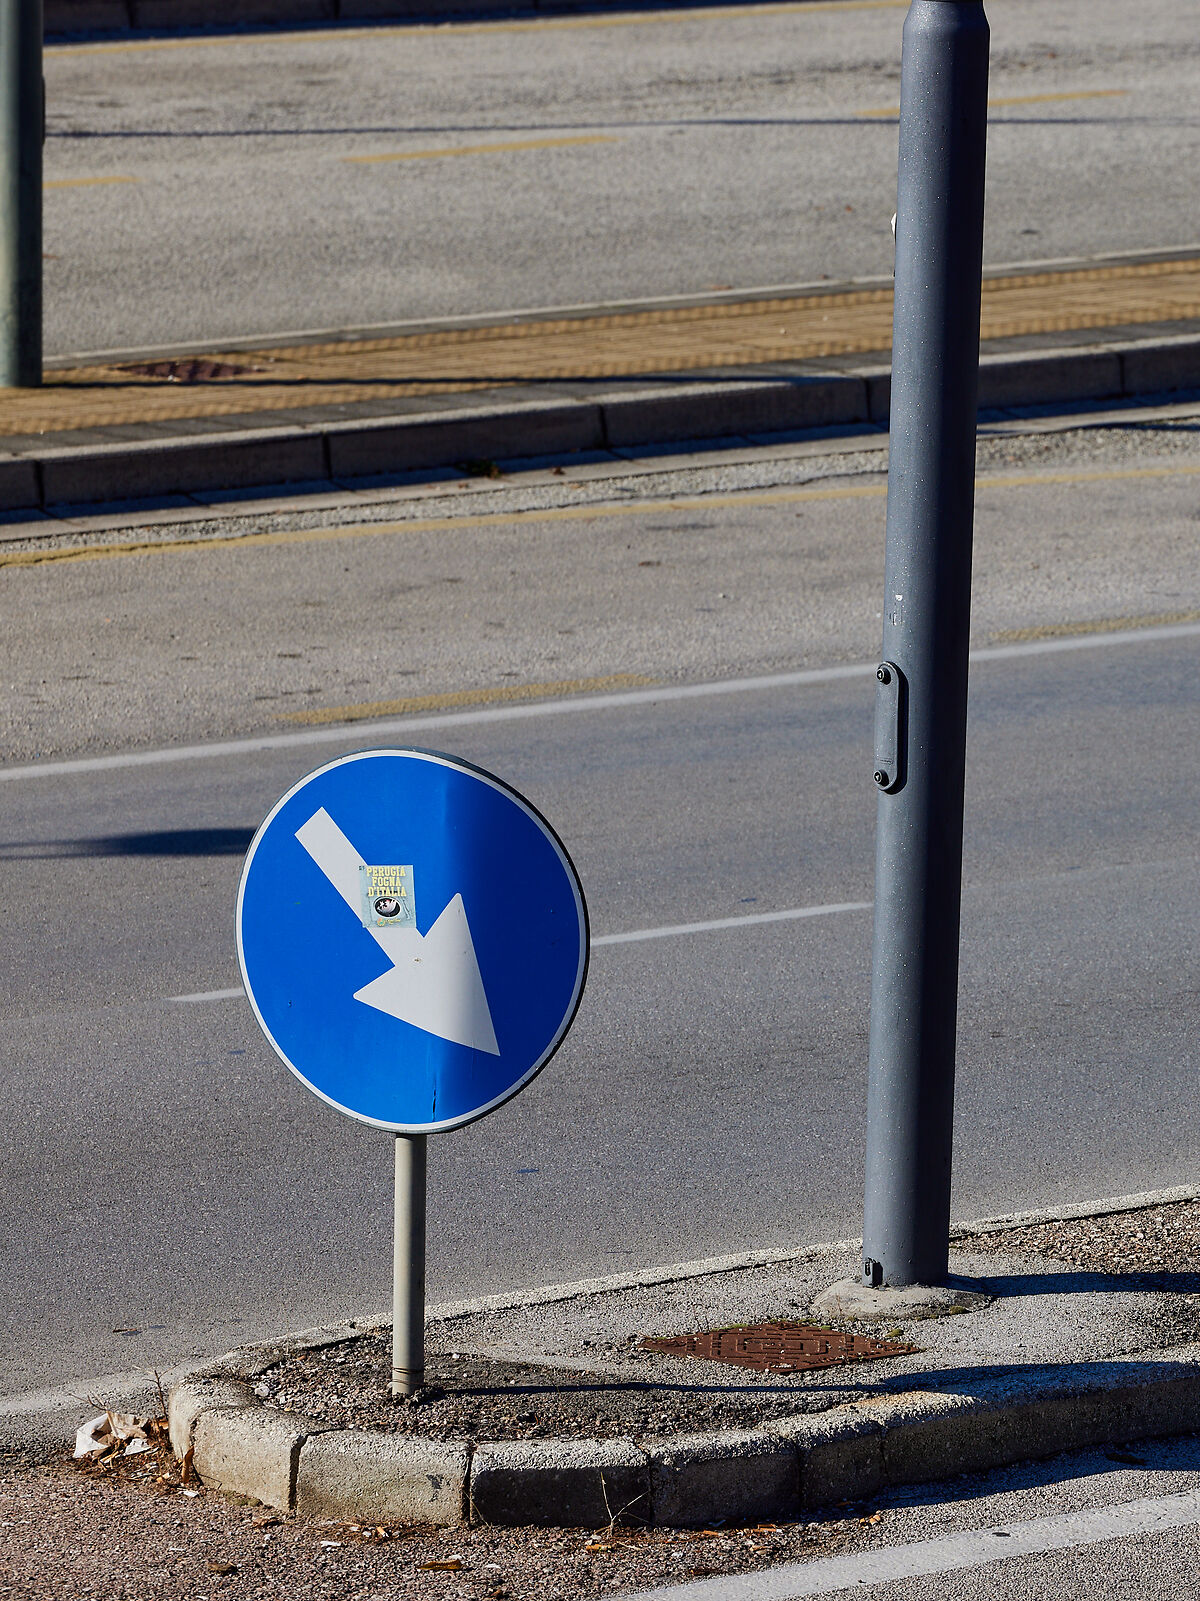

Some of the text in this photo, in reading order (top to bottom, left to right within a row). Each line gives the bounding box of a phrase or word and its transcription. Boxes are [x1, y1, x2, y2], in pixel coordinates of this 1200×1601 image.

[367, 866, 406, 877] PERUGIA
[372, 877, 402, 887] FOGNA
[368, 887, 407, 897] D'ITALIA
